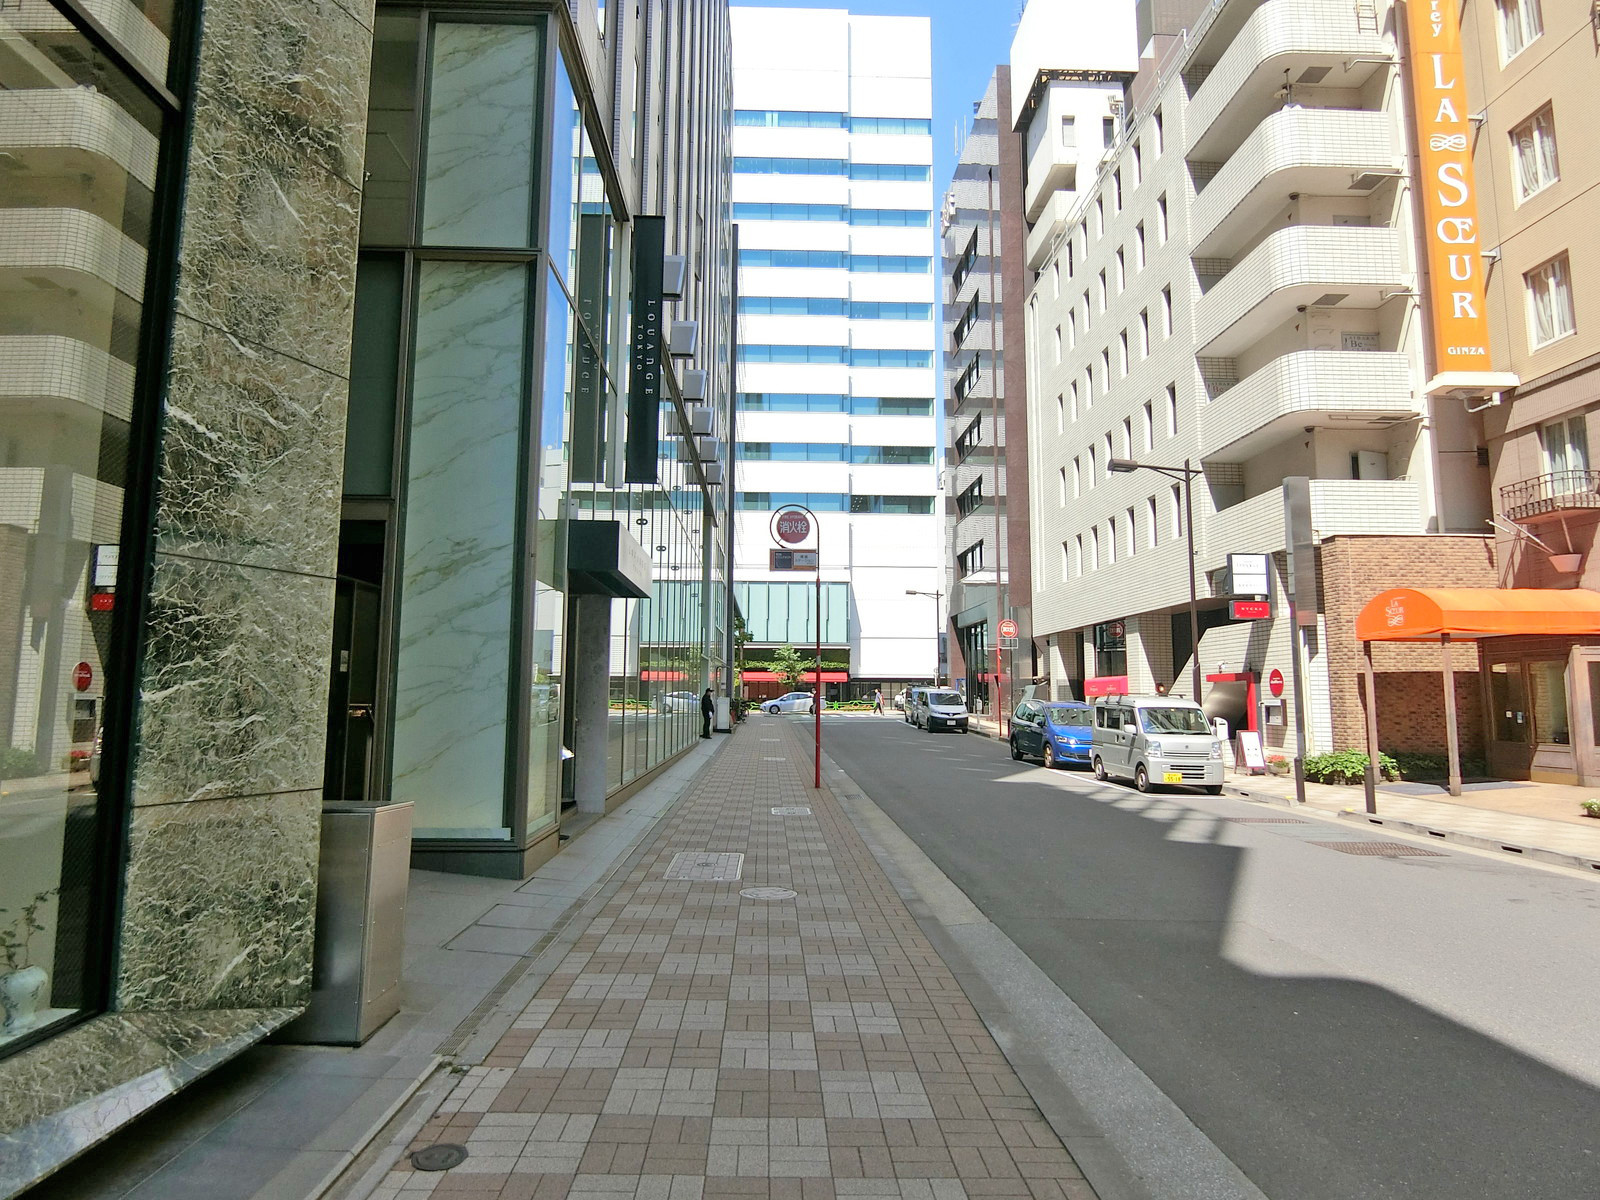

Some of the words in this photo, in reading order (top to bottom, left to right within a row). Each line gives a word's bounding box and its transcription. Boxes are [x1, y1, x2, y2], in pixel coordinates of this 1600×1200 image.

[1431, 53, 1460, 123] LA
[636, 324, 644, 371] TOKYO
[645, 300, 656, 395] LOUANGE
[1447, 346, 1486, 356] GINZA
[779, 520, 807, 534] 消火栓
